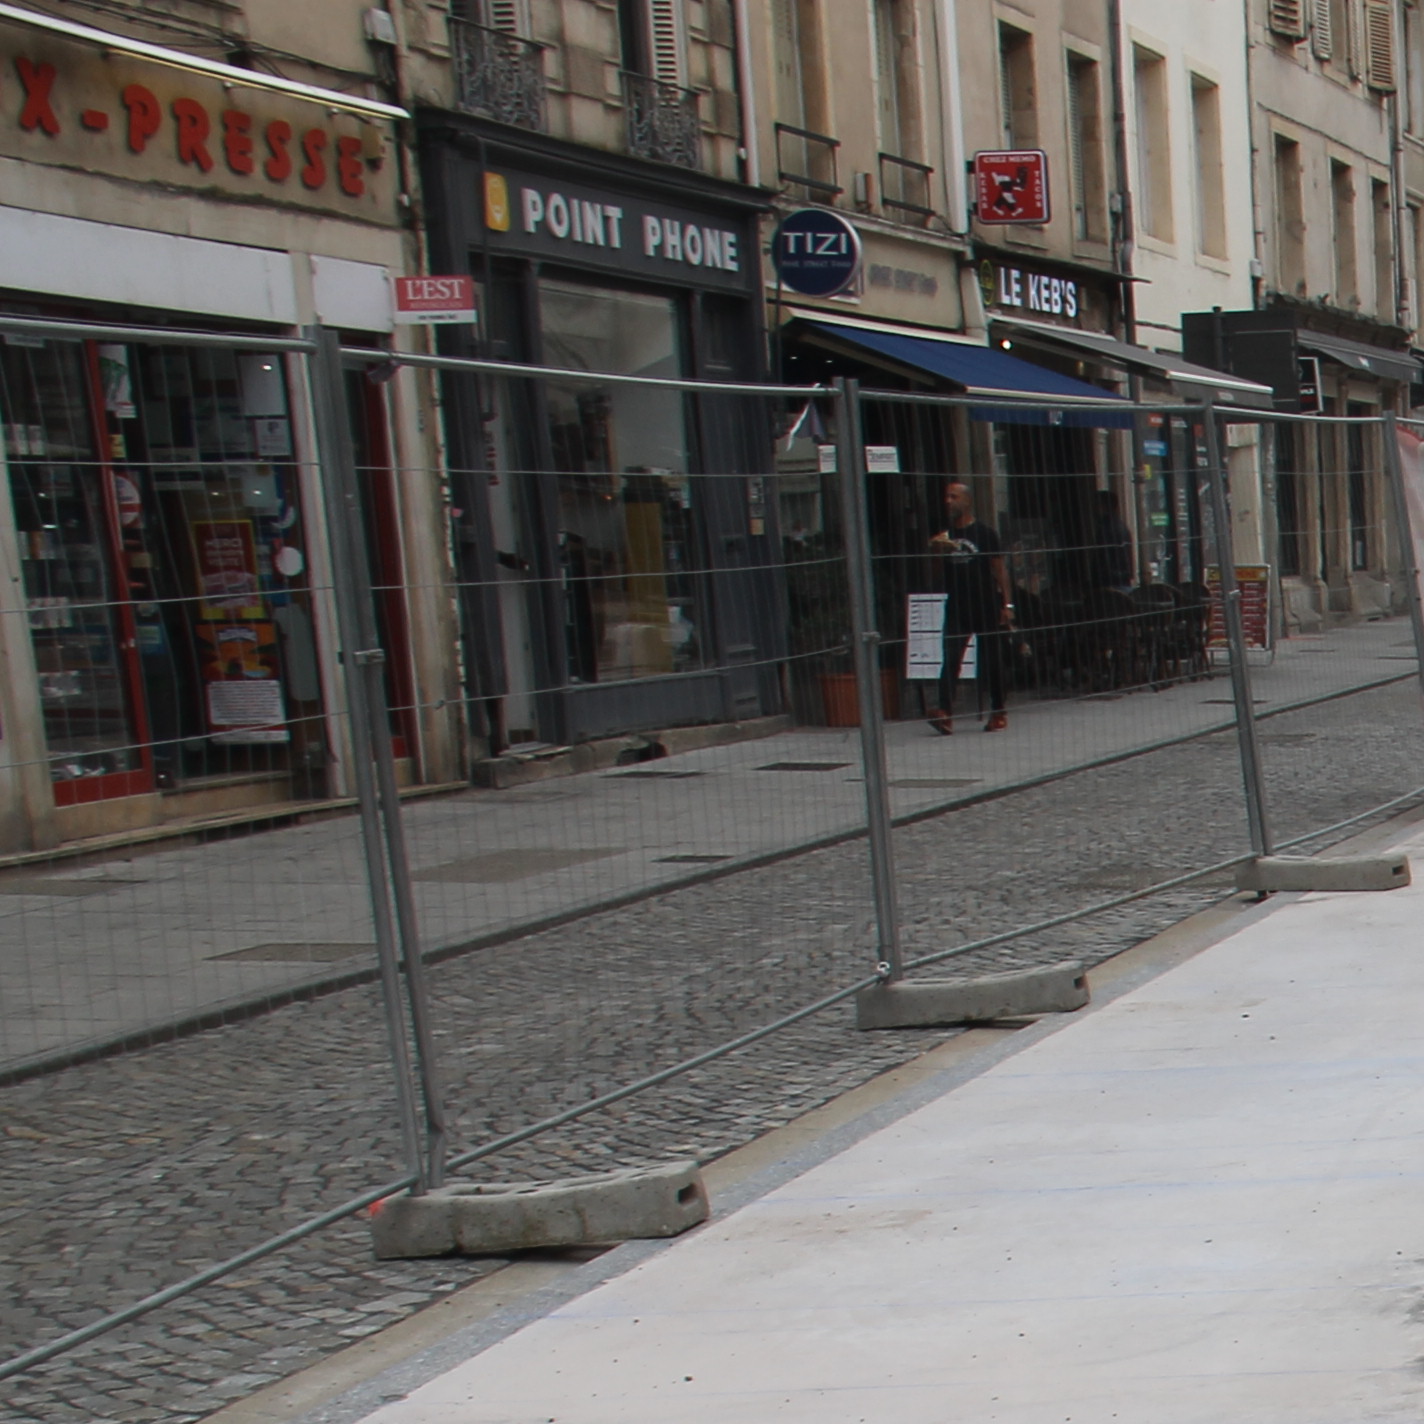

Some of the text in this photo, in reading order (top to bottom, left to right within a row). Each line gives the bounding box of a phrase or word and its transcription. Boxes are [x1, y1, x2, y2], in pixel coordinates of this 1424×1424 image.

[1034, 170, 1042, 208] TACOS
[520, 187, 739, 272] POINT PHONE
[782, 232, 848, 256] TIZI
[405, 279, 464, 300] L'EST
[1000, 266, 1077, 318] LE KEB'S
